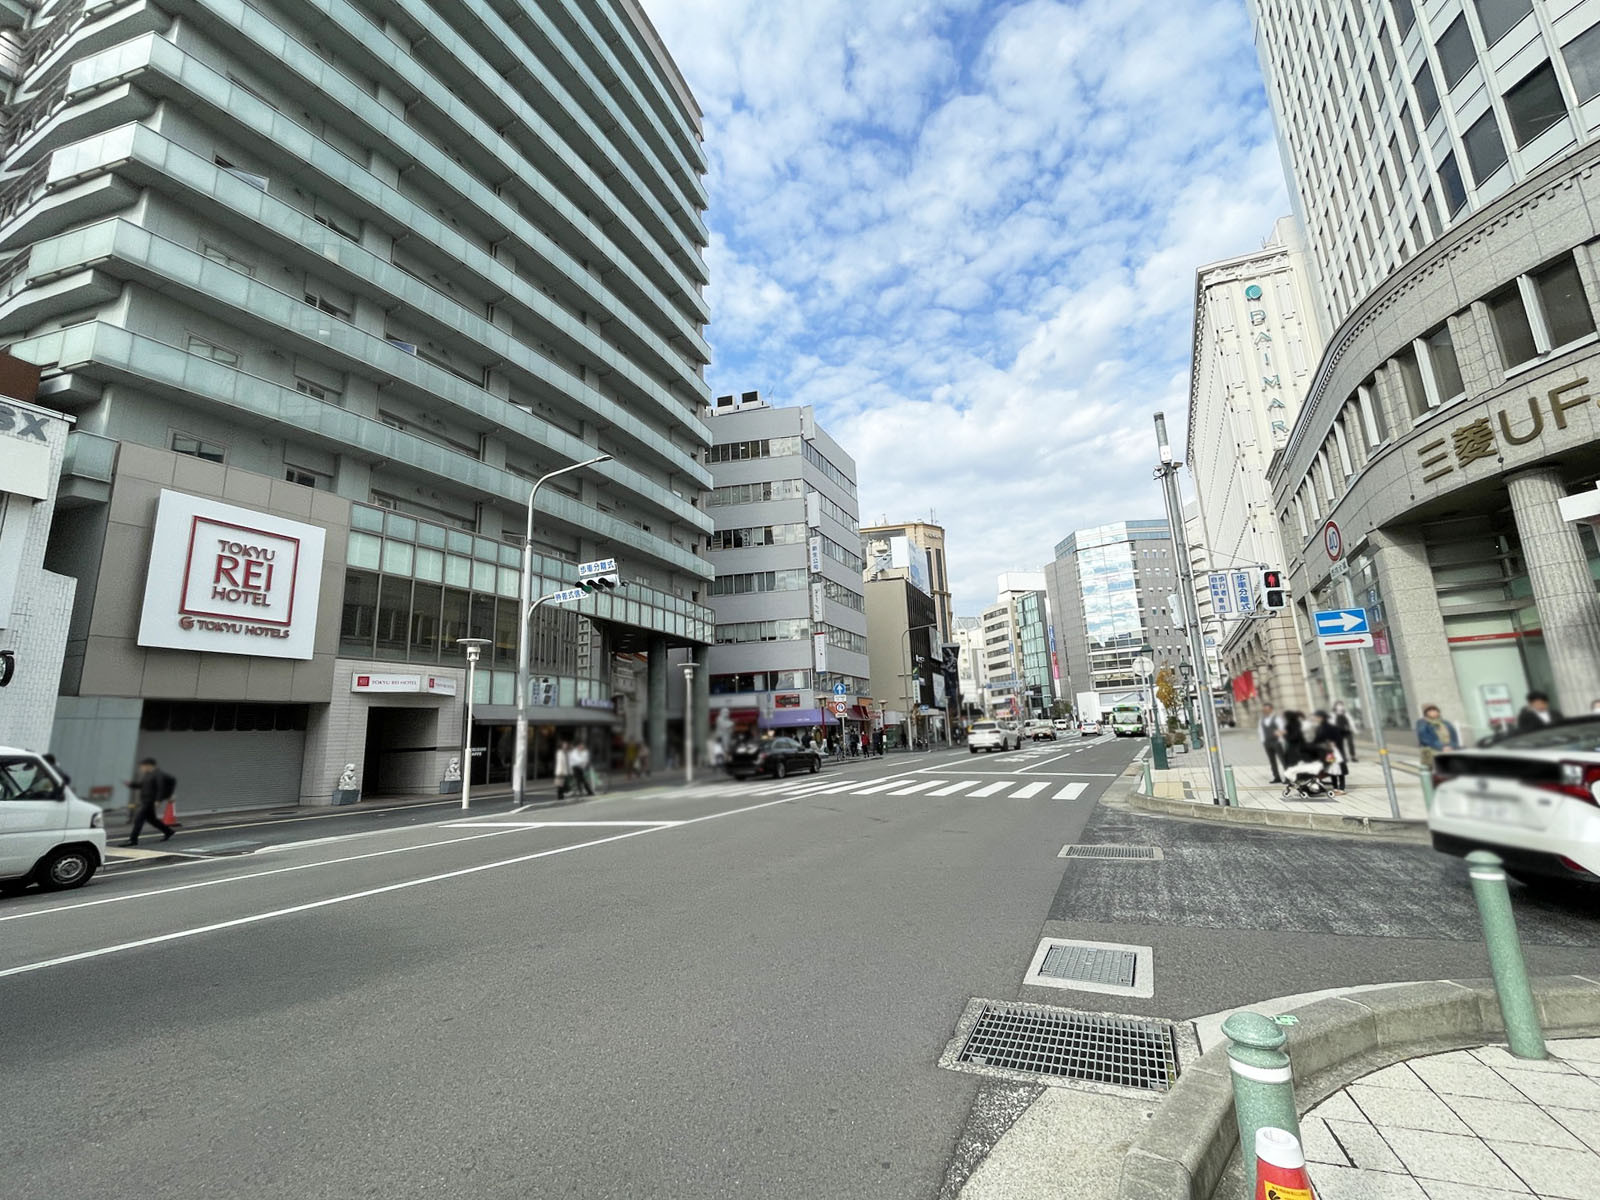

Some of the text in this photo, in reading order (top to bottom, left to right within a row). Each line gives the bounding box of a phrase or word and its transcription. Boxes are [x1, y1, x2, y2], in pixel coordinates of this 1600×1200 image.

[1417, 376, 1600, 484] 三菱UF
[217, 539, 276, 561] TOKYU
[213, 554, 274, 592] REI
[211, 586, 272, 607] HOTEL
[1236, 574, 1252, 611] 歩車分離式
[197, 619, 290, 639] TOKYU HOTELS
